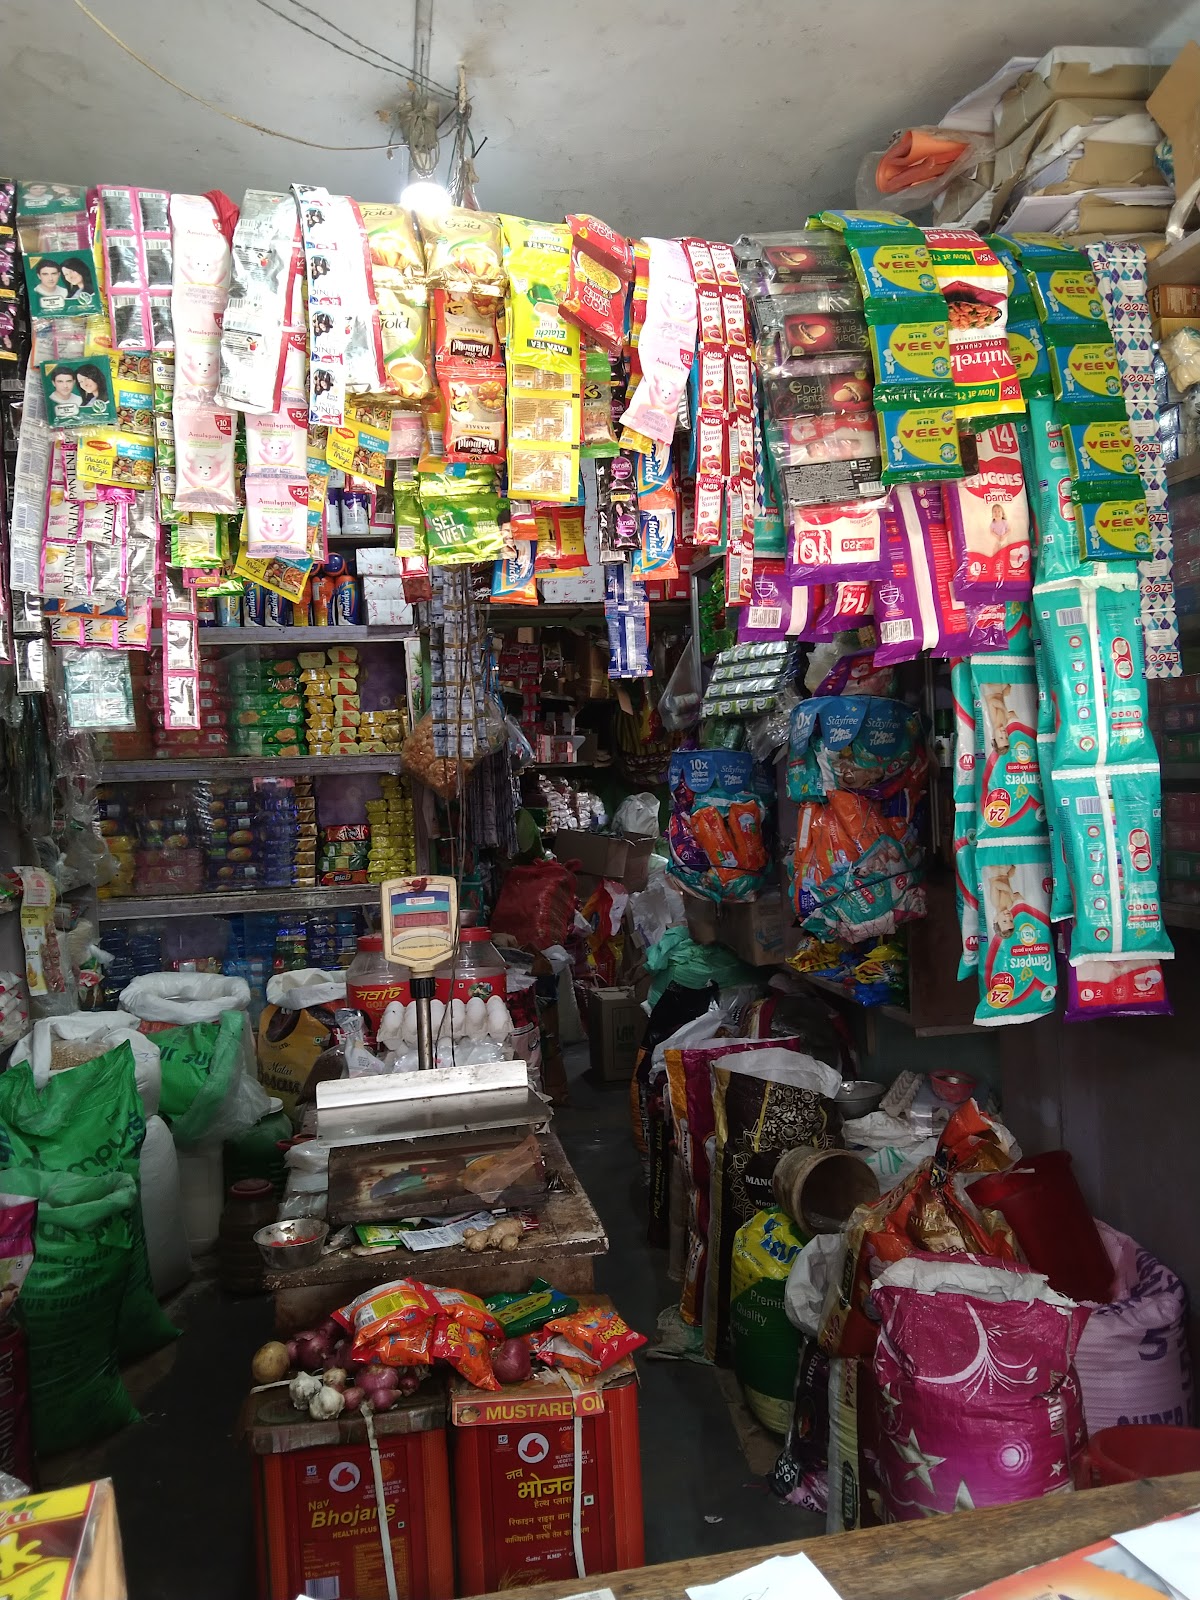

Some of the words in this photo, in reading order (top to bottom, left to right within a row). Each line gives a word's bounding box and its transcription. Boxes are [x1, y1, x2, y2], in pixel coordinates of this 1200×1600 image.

[878, 260, 929, 270] VEEV
[1053, 286, 1096, 295] VEEV
[581, 294, 610, 317] TOP
[536, 329, 566, 339] Elaichi
[834, 335, 856, 344] Dark
[530, 340, 547, 348] TEA
[894, 340, 946, 352] VEEV
[956, 342, 982, 350] CHUNKS
[1072, 362, 1116, 372] VEEV
[802, 384, 826, 394] Dark
[980, 388, 996, 397] Now
[257, 420, 296, 430] Amulspray
[188, 432, 223, 440] Amulspray
[902, 426, 954, 438] VEEV
[1087, 440, 1132, 450] VEEV
[258, 498, 297, 508] Amulspray
[984, 492, 1013, 504] pants
[432, 512, 455, 530] SET
[1098, 518, 1146, 528] VEEV
[436, 524, 467, 545] WET
[648, 519, 658, 558] Horlicks
[64, 545, 76, 596] PANTENE
[1144, 582, 1174, 594] Ezee
[342, 589, 350, 621] Horlicks
[1150, 652, 1180, 663] Ezee
[826, 714, 858, 726] Stayfree
[865, 718, 901, 730] Stayfree
[690, 759, 708, 770] 10x
[720, 765, 746, 775] Stayfree
[1004, 773, 1044, 789] ampers
[988, 808, 1006, 822] 24
[1010, 956, 1052, 972] Pampers
[356, 986, 404, 1002] সম্রাট
[991, 990, 1010, 1002] 24
[736, 1302, 768, 1326] Quality
[486, 1402, 577, 1421] MUSTARD
[505, 1468, 524, 1480] नव
[308, 1498, 330, 1512] Nav
[332, 1528, 359, 1540] HEALTH
[360, 1526, 378, 1536] PLUS
